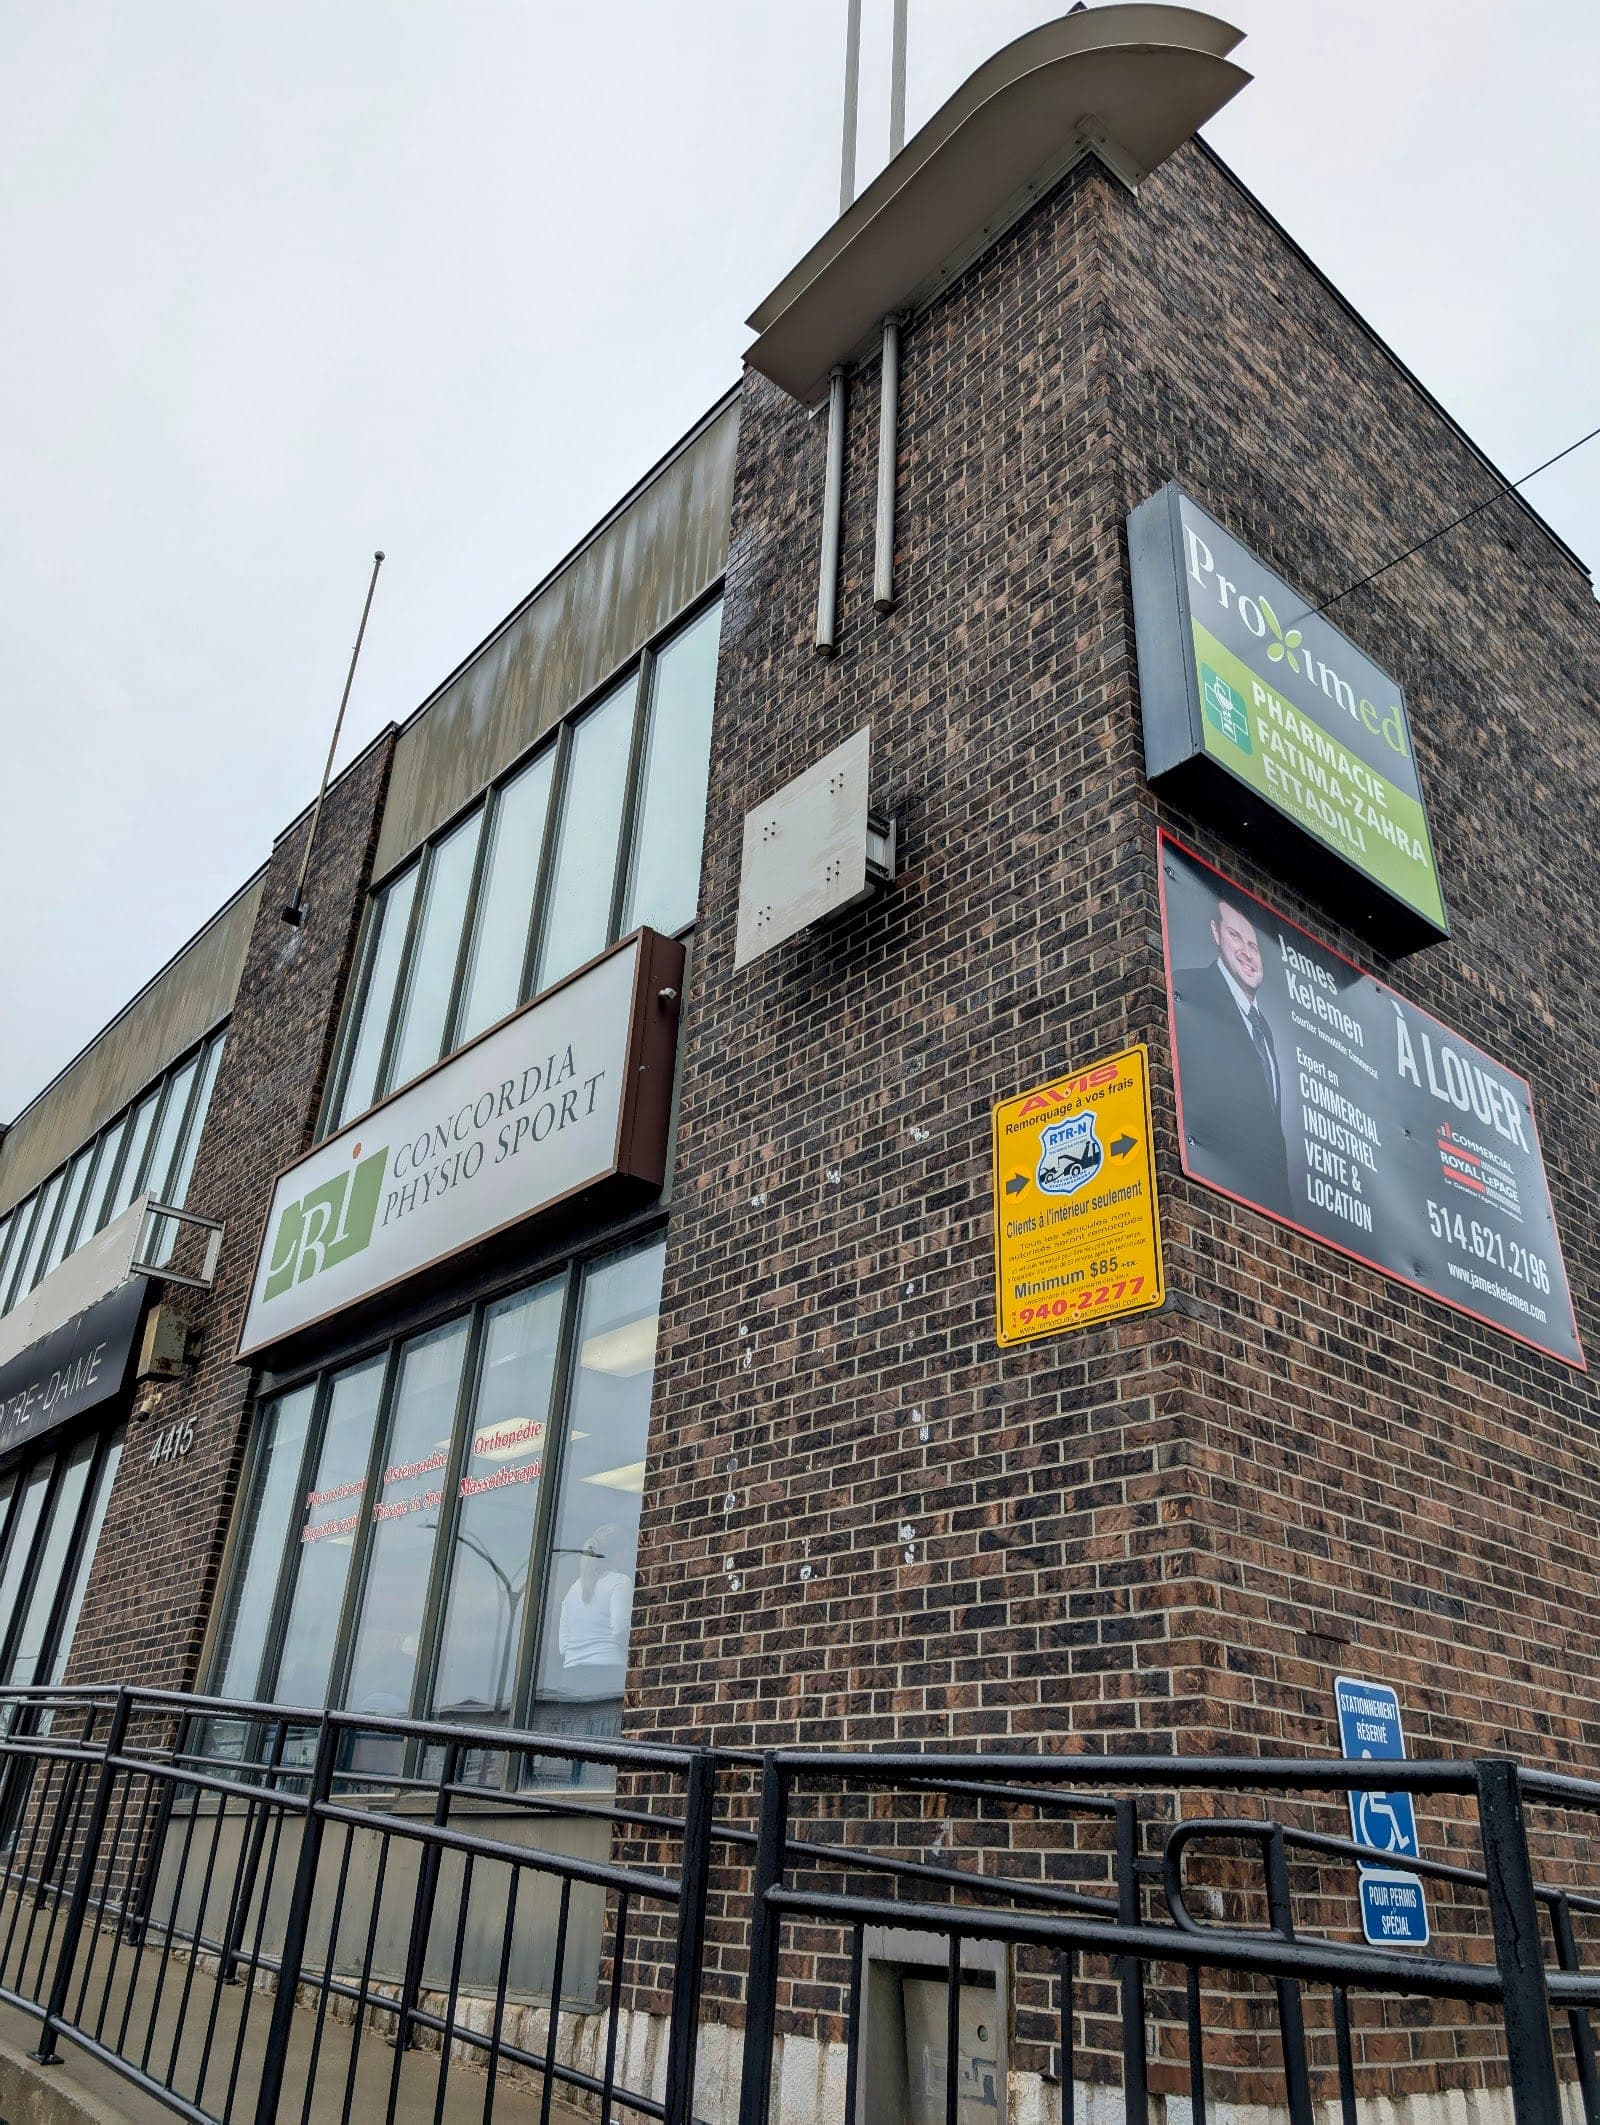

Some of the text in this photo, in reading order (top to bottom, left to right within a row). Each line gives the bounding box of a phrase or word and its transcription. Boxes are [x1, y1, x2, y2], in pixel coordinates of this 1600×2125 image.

[1252, 681, 1388, 809] PHARMACIE
[1257, 716, 1428, 868] FATIMA-ZAHRA
[1262, 752, 1367, 853] ETTADILI
[1278, 934, 1338, 996] James
[1285, 969, 1364, 1048] Kelemen
[1018, 1064, 1119, 1118] AVIS
[1296, 1046, 1340, 1087] Expert en
[1390, 999, 1530, 1155] À LOUER
[393, 1044, 577, 1179] CONCORDIA
[1005, 1078, 1134, 1135] Remorquage à vos frais
[1049, 1122, 1087, 1146] RTR-N
[1300, 1072, 1382, 1147] COMMERCIAL
[380, 1070, 606, 1228] PHYSIO SPORT
[1303, 1104, 1378, 1173] INDUSTRIEL
[1304, 1137, 1362, 1194] VENTE &
[1440, 1150, 1481, 1181] ROYAL
[1451, 1131, 1515, 1175] COMMERCIAL
[1006, 1179, 1143, 1239] Clients à l'intérieur seulement
[1019, 1211, 1131, 1251] Tous les véhicules non
[1054, 1234, 1086, 1247] seront
[1087, 1215, 1144, 1236] remorqués
[1306, 1173, 1373, 1233] LOCATION
[1426, 1199, 1551, 1295] 514.621.2196
[1014, 1269, 1085, 1300] Minimum
[1089, 1256, 1119, 1279] $85
[1019, 1276, 1145, 1325] 940-2277
[1447, 1262, 1547, 1324] www.jameskelemen.com
[149, 1416, 198, 1468] 4415
[474, 1420, 542, 1455] Orthopédie
[1340, 1693, 1396, 1721] STATIONNEMENT
[1356, 1718, 1389, 1744] RÉSERVÉ
[1368, 1886, 1417, 1908] POUR PERMIS
[1381, 1910, 1412, 1936] SPÉCIAL
